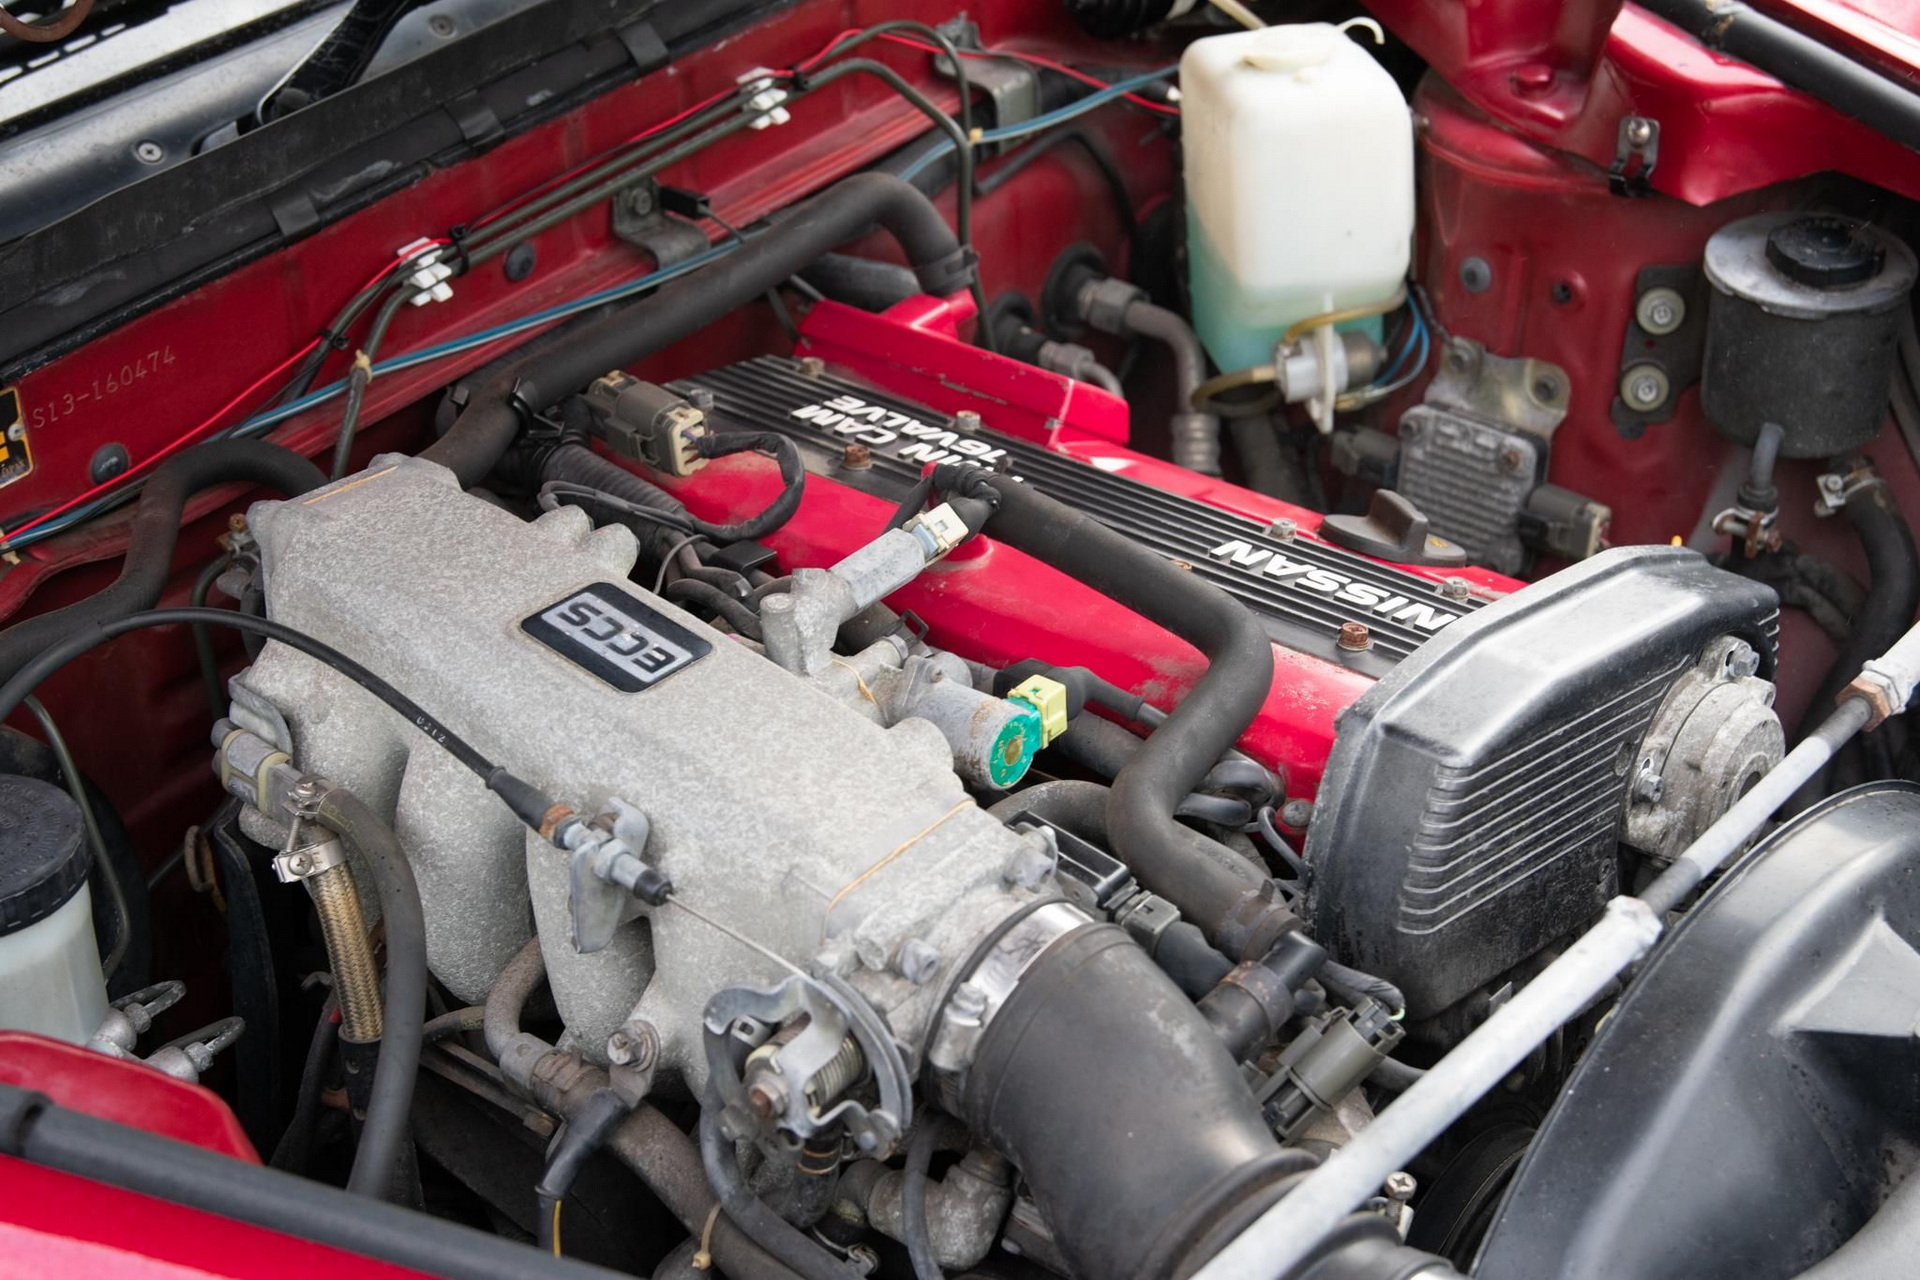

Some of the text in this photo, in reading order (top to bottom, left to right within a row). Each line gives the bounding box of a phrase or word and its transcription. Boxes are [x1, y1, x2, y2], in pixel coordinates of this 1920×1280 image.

[33, 345, 175, 429] S13-160474
[791, 404, 897, 445] CAM
[823, 395, 1006, 463] 16VALVE
[1210, 539, 1457, 631] NISSAN
[556, 601, 677, 674] ECCS
